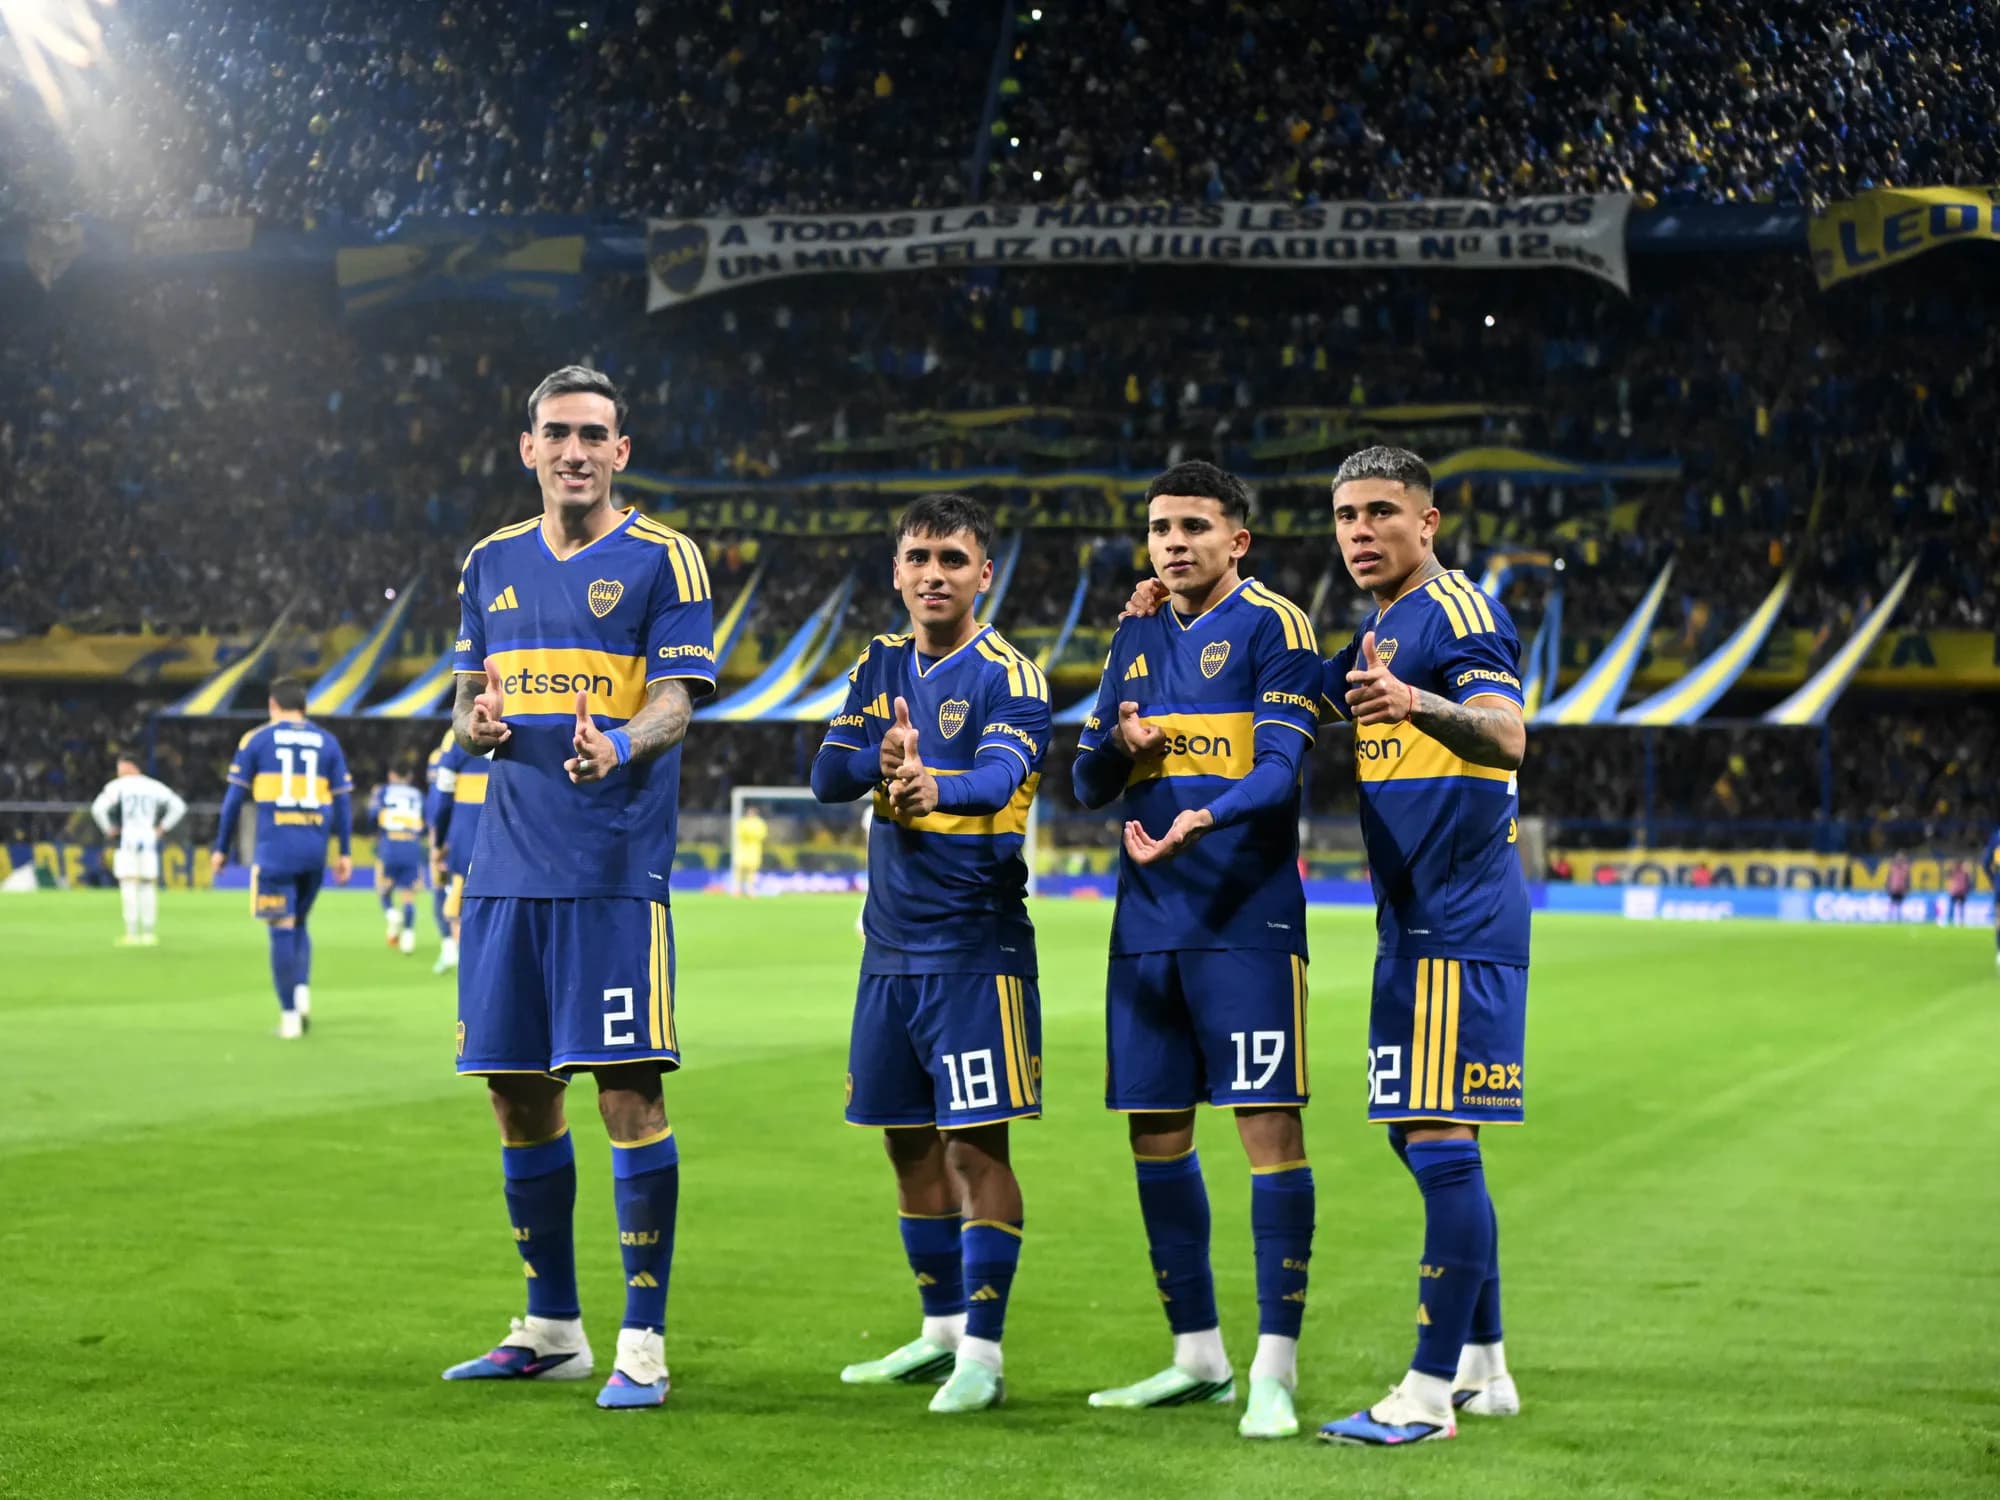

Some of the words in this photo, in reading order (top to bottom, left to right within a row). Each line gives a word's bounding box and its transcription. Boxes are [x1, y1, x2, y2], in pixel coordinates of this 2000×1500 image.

[718, 224, 748, 246] A
[766, 216, 916, 243] TODAS
[931, 206, 1020, 234] LAS
[1035, 204, 1224, 229] MADRES
[1236, 206, 1328, 231] LES
[1341, 198, 1593, 231] DESEAMOS
[718, 253, 781, 280] UN
[795, 246, 897, 270] MUY
[906, 236, 1037, 264] FELIZ
[501, 668, 613, 697] etsson
[275, 747, 320, 809] 11
[603, 987, 635, 1046] 2
[941, 1048, 998, 1111] 18
[1230, 1030, 1286, 1090] 19
[1462, 1062, 1522, 1094] pax
[1462, 1095, 1522, 1107] assistance
[620, 1230, 660, 1245] CABJ
